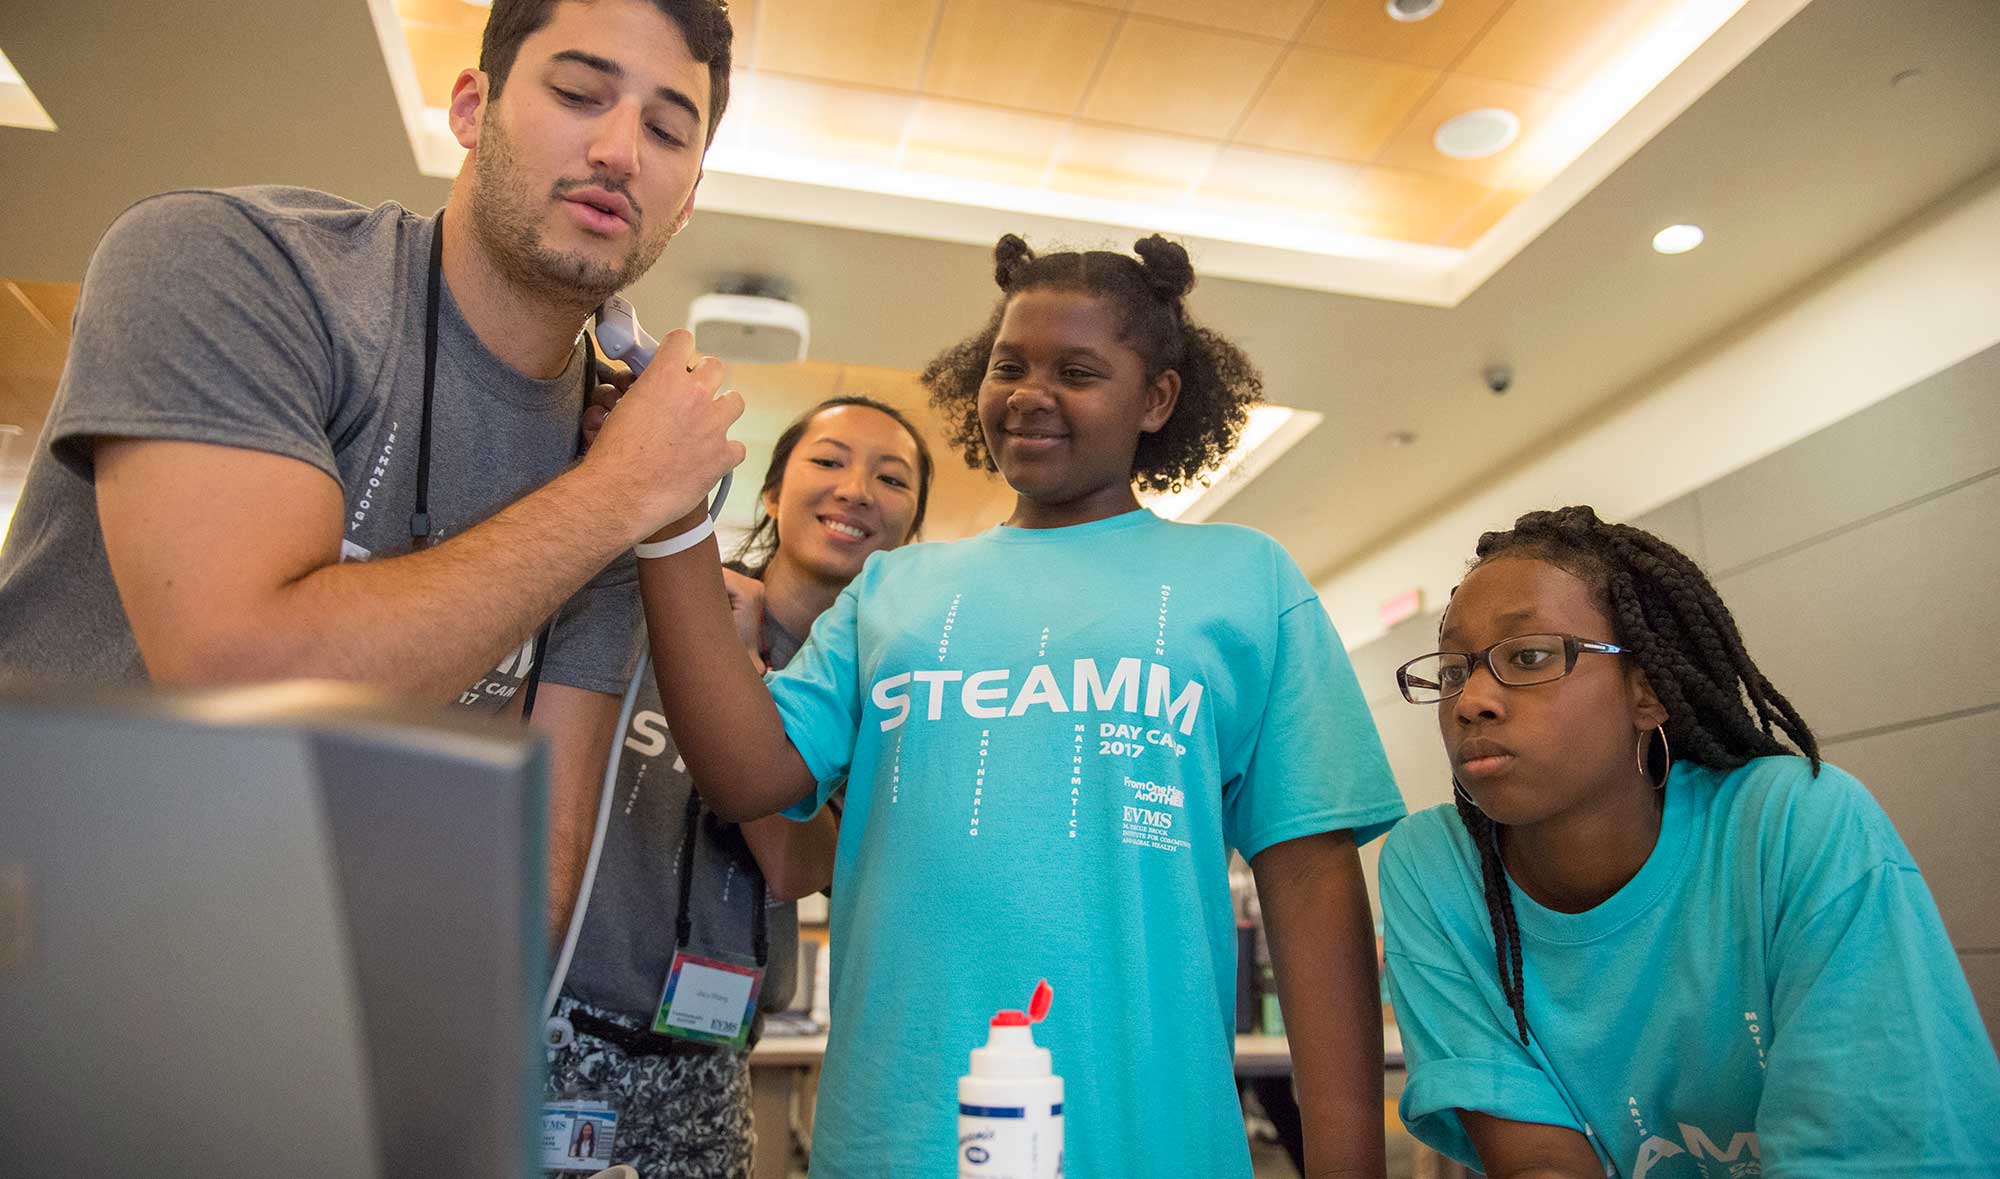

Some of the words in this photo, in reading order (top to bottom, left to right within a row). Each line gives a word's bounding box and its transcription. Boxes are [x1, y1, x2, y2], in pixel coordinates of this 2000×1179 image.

[351, 421, 398, 531] TECHNOLOGY
[938, 594, 961, 662] TECHNOLOGY
[1156, 584, 1171, 656] MOTIVATION
[1039, 626, 1050, 657] ARTS
[459, 691, 480, 705] 17
[485, 682, 518, 698] CAM
[871, 656, 1205, 737] STEAMM
[1099, 741, 1145, 758] 2017
[1100, 723, 1143, 740] DAY
[1146, 729, 1187, 757] CAP
[969, 729, 990, 836] ENGINEERING
[1069, 724, 1085, 838] MATHEMATICS
[1124, 776, 1145, 790] From
[1146, 781, 1167, 794] One
[1135, 790, 1184, 808] AnOTHE
[1123, 805, 1172, 829] EVMS
[1744, 1011, 1767, 1069] MOTIV
[543, 1119, 567, 1129] VMS
[1629, 1096, 1648, 1136] ARTS
